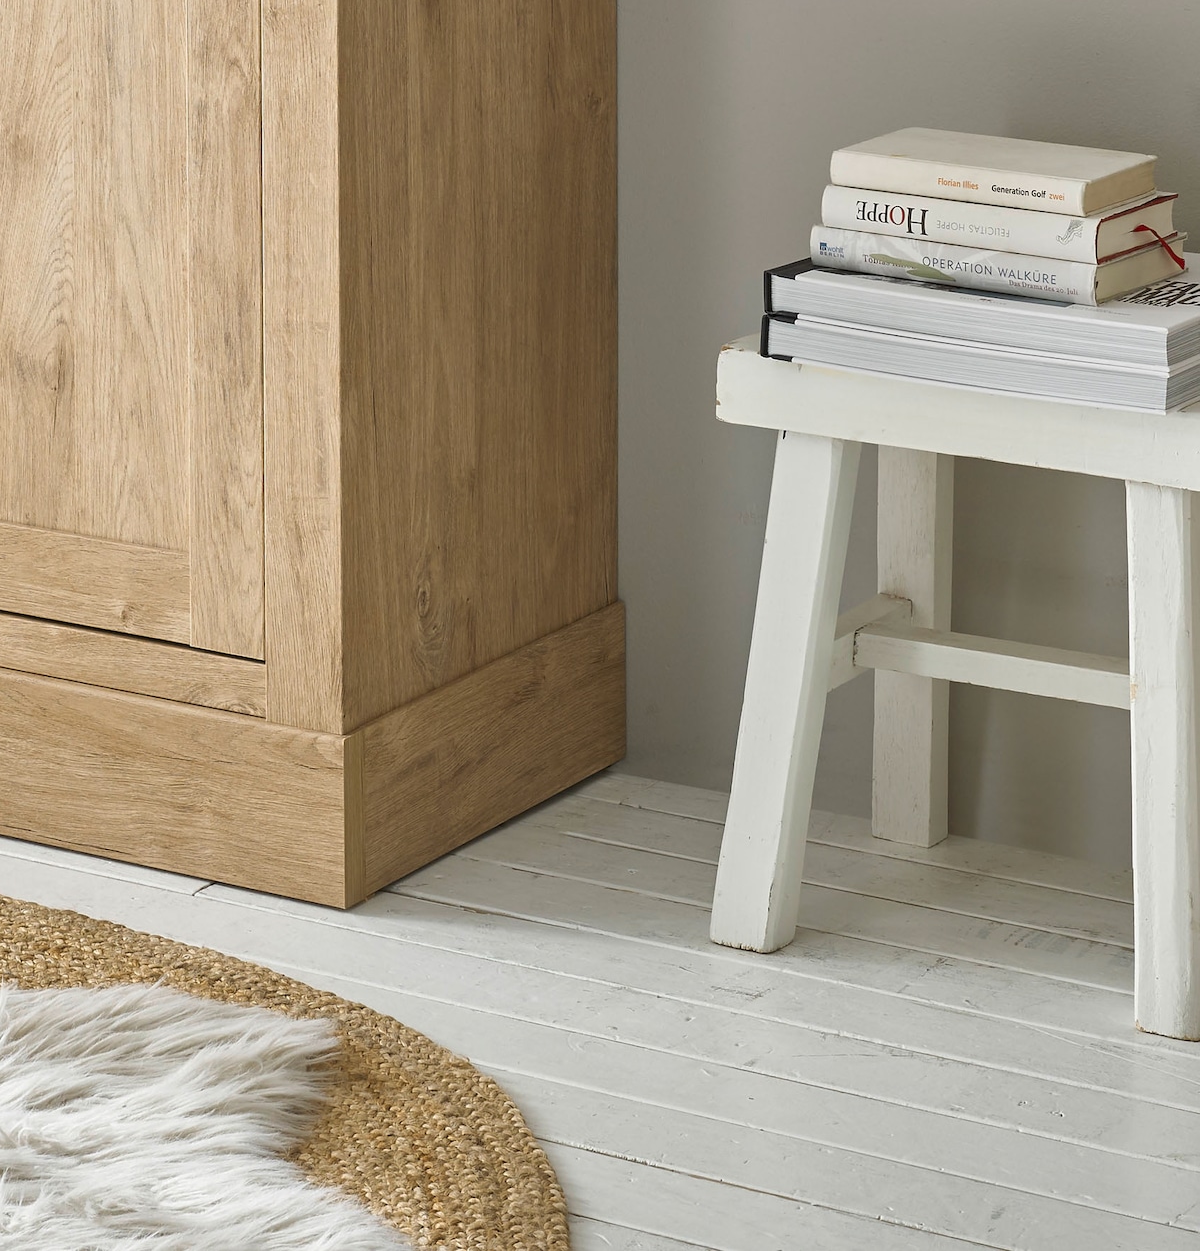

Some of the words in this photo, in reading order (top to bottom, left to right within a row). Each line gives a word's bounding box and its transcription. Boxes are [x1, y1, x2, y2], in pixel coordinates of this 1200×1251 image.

[938, 178, 960, 188] Florian
[962, 181, 979, 190] Illies
[991, 184, 1030, 196] Generation
[1031, 190, 1046, 199] Golf
[1049, 193, 1065, 201] zwei
[856, 200, 929, 236] HOPPE
[936, 220, 965, 232] HOPPE
[968, 224, 1010, 237] FELICITAS
[922, 256, 992, 275] OPERATION
[998, 267, 1057, 285] WALKÜRE
[1022, 281, 1043, 291] Drama
